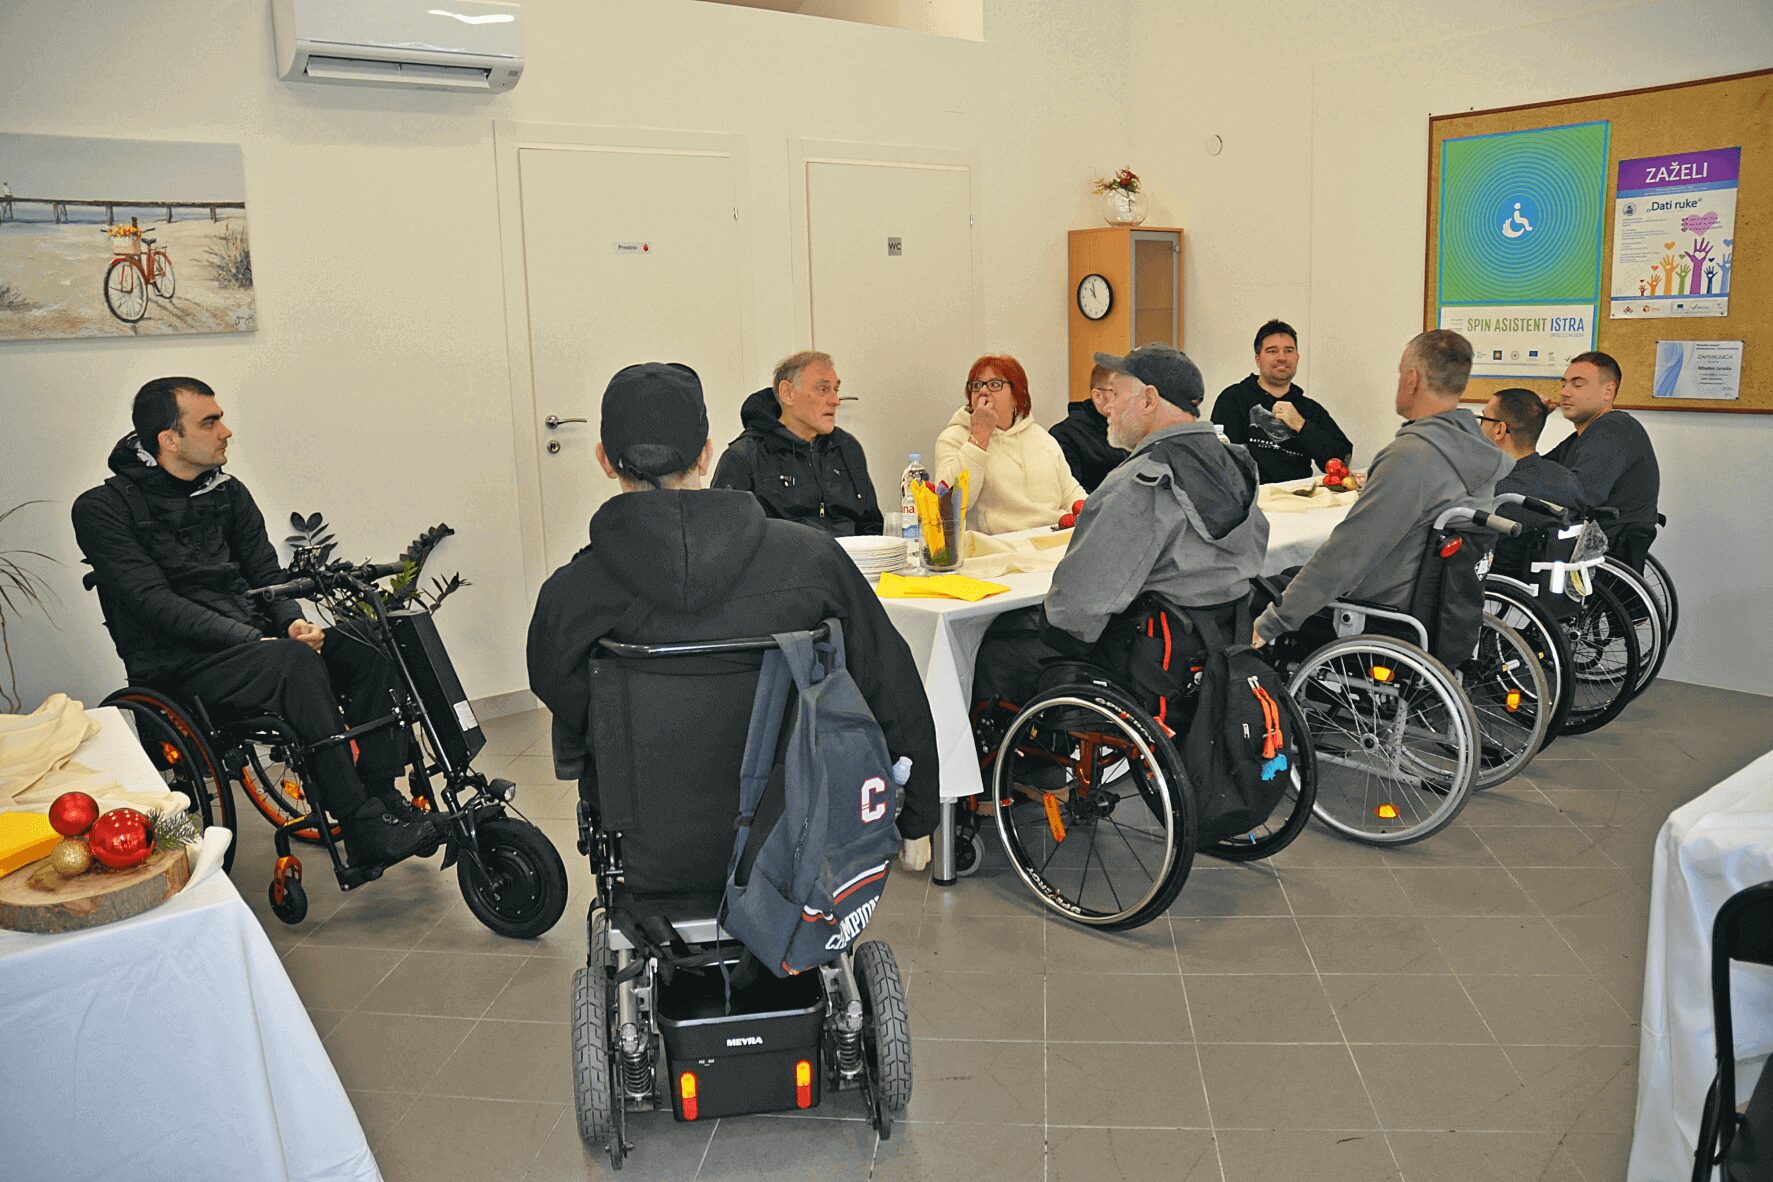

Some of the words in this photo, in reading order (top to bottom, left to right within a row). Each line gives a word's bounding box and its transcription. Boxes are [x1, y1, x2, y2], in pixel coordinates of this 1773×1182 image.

[1645, 161, 1708, 183] ZAŽELI
[888, 242, 902, 251] WC
[1467, 318, 1491, 332] SPIN
[1494, 318, 1547, 332] ASISTENT
[1550, 317, 1585, 332] ISTRA
[861, 776, 887, 824] C
[726, 1036, 763, 1047] MEYRA
